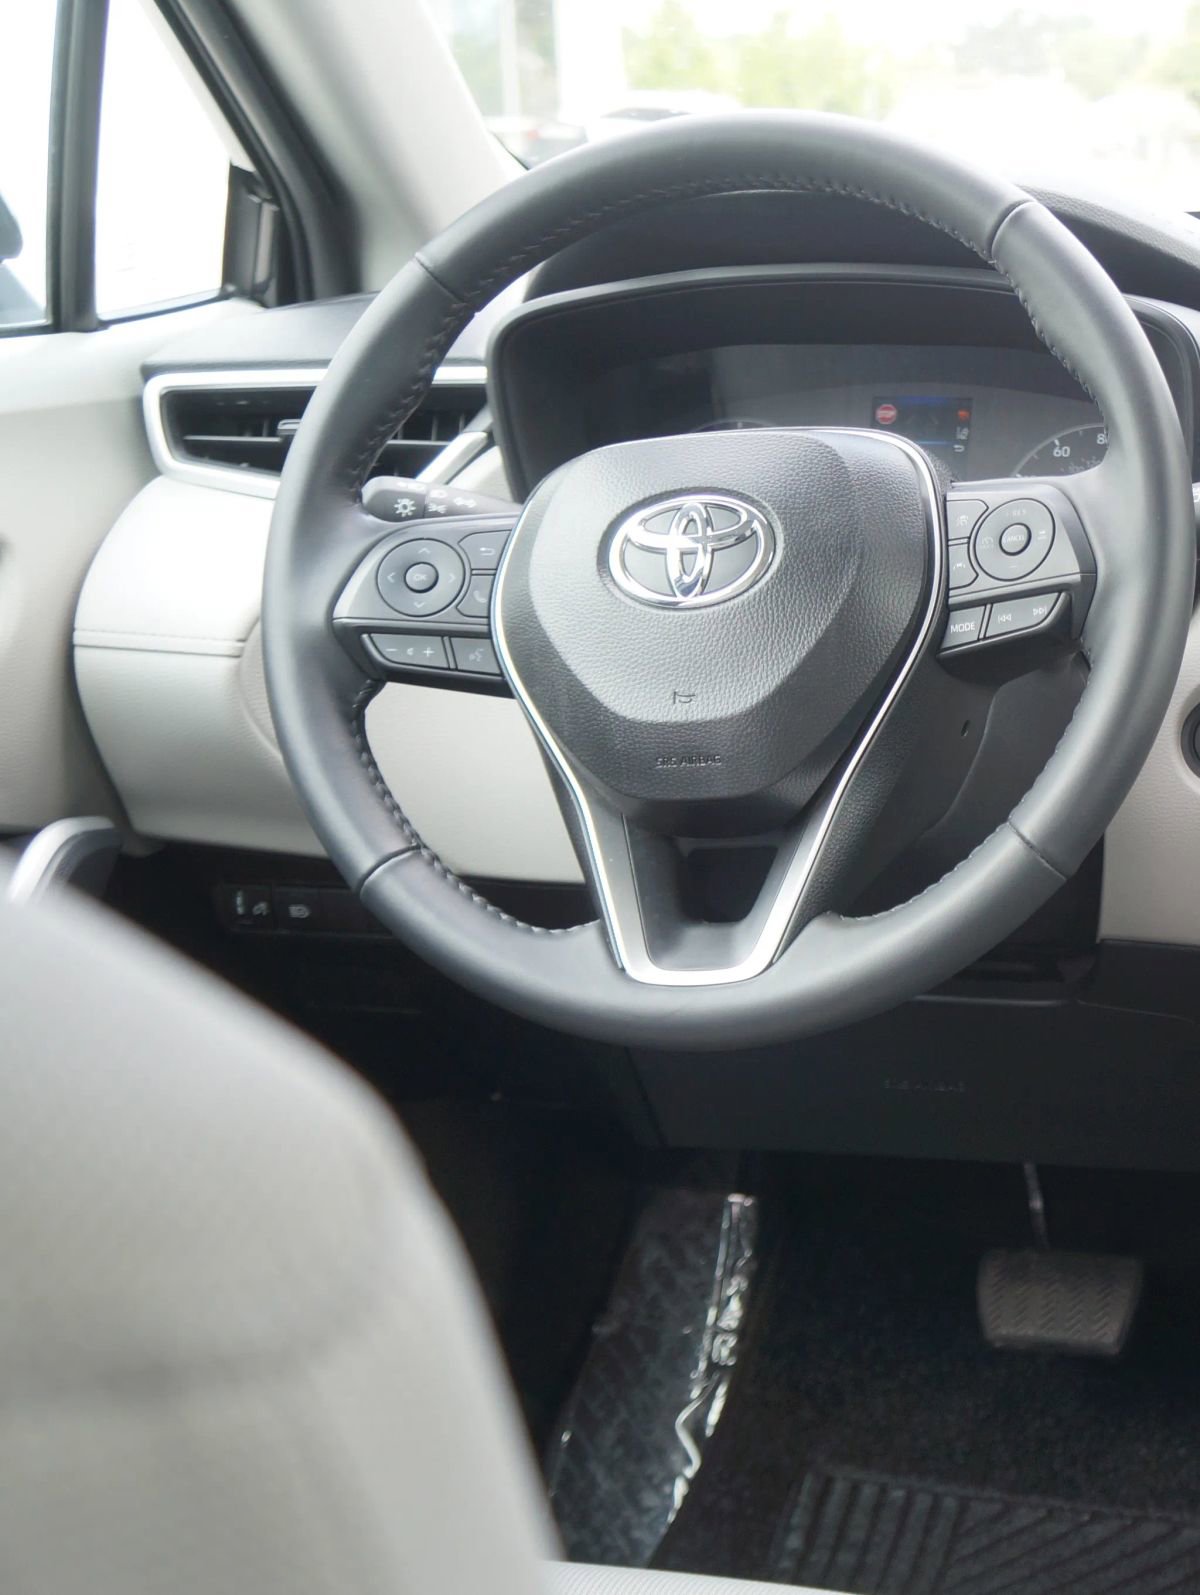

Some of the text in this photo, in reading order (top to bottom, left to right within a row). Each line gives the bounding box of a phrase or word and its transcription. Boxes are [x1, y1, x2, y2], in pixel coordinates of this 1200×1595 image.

[1096, 433, 1109, 445] 8
[1053, 446, 1071, 458] 60
[412, 573, 428, 581] OK
[950, 621, 976, 634] MODE
